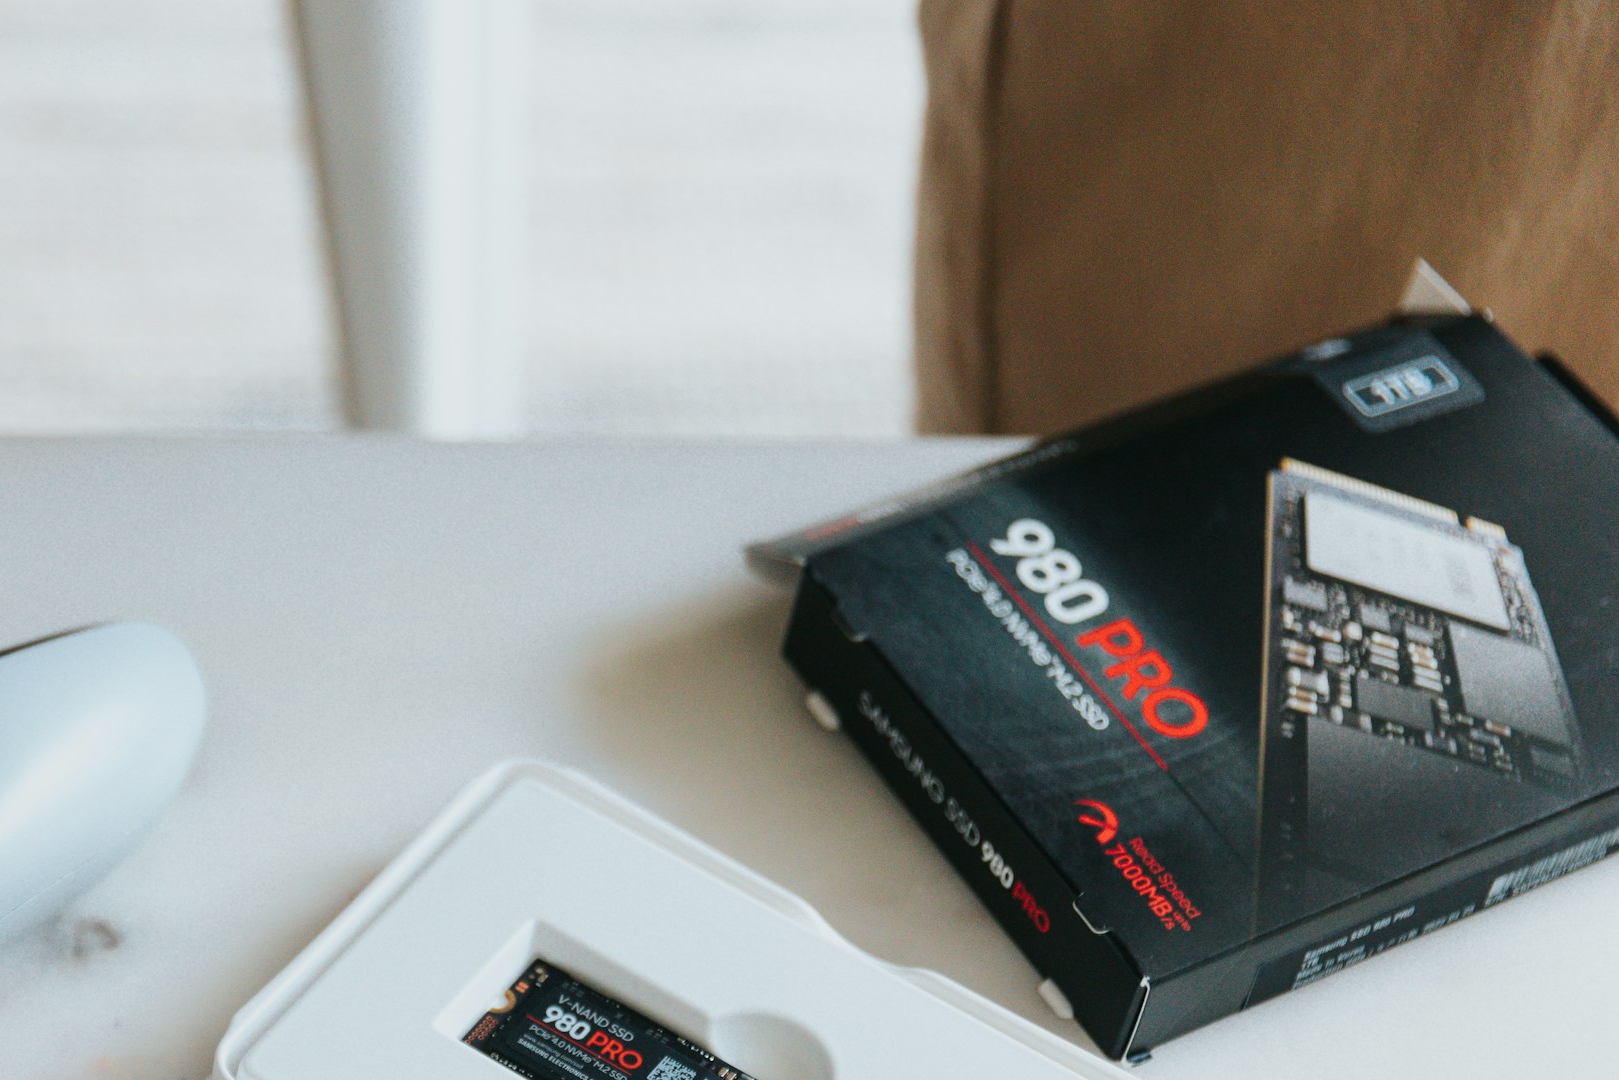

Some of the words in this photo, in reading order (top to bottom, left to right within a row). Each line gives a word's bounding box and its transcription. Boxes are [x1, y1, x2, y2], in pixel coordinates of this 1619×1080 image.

[989, 518, 1109, 624] 980
[1076, 617, 1209, 739] PRO
[1072, 693, 1110, 731] SSD
[858, 691, 945, 804] SAMSUNG
[944, 797, 980, 847] SSD
[981, 840, 1014, 889] 980
[1012, 880, 1050, 933] PRO
[1105, 842, 1177, 931] 7000MB/s
[1129, 835, 1166, 875] Read
[1158, 872, 1202, 919] Speed
[517, 1038, 550, 1059] SAMSUNG
[543, 1006, 591, 1040] 980
[586, 1031, 643, 1069] PRO
[558, 994, 610, 1028] V-NAND
[608, 1023, 634, 1042] SSD
[592, 1060, 611, 1074] M.2
